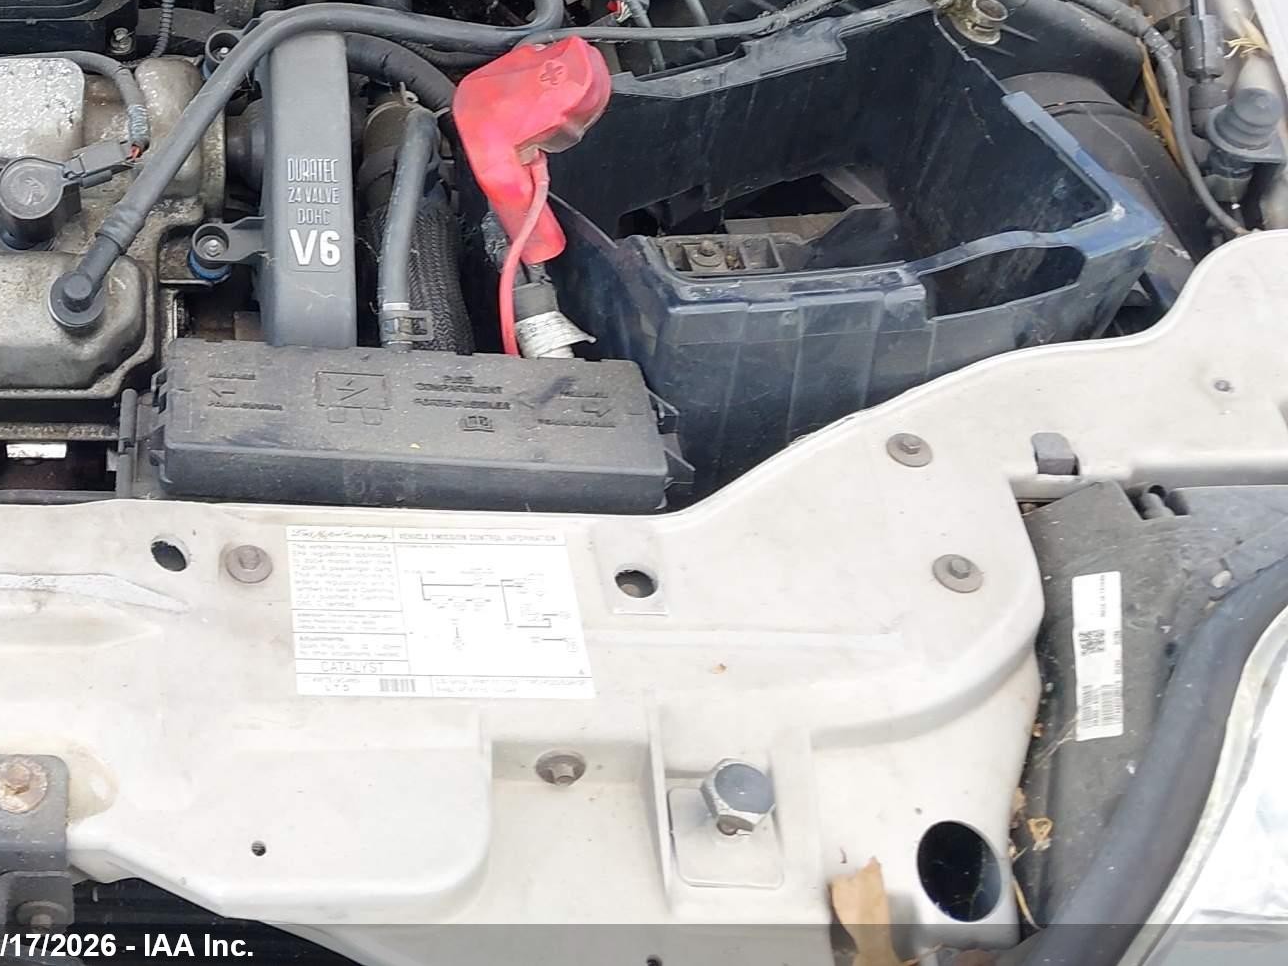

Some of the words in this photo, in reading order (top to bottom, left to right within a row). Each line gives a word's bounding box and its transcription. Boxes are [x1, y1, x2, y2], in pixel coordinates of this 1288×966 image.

[288, 159, 339, 183] DURATEC
[287, 186, 303, 205] 24
[304, 186, 341, 205] VALVE
[297, 208, 331, 226] DOHC
[289, 229, 342, 267] V6
[320, 661, 385, 674] CATALYST
